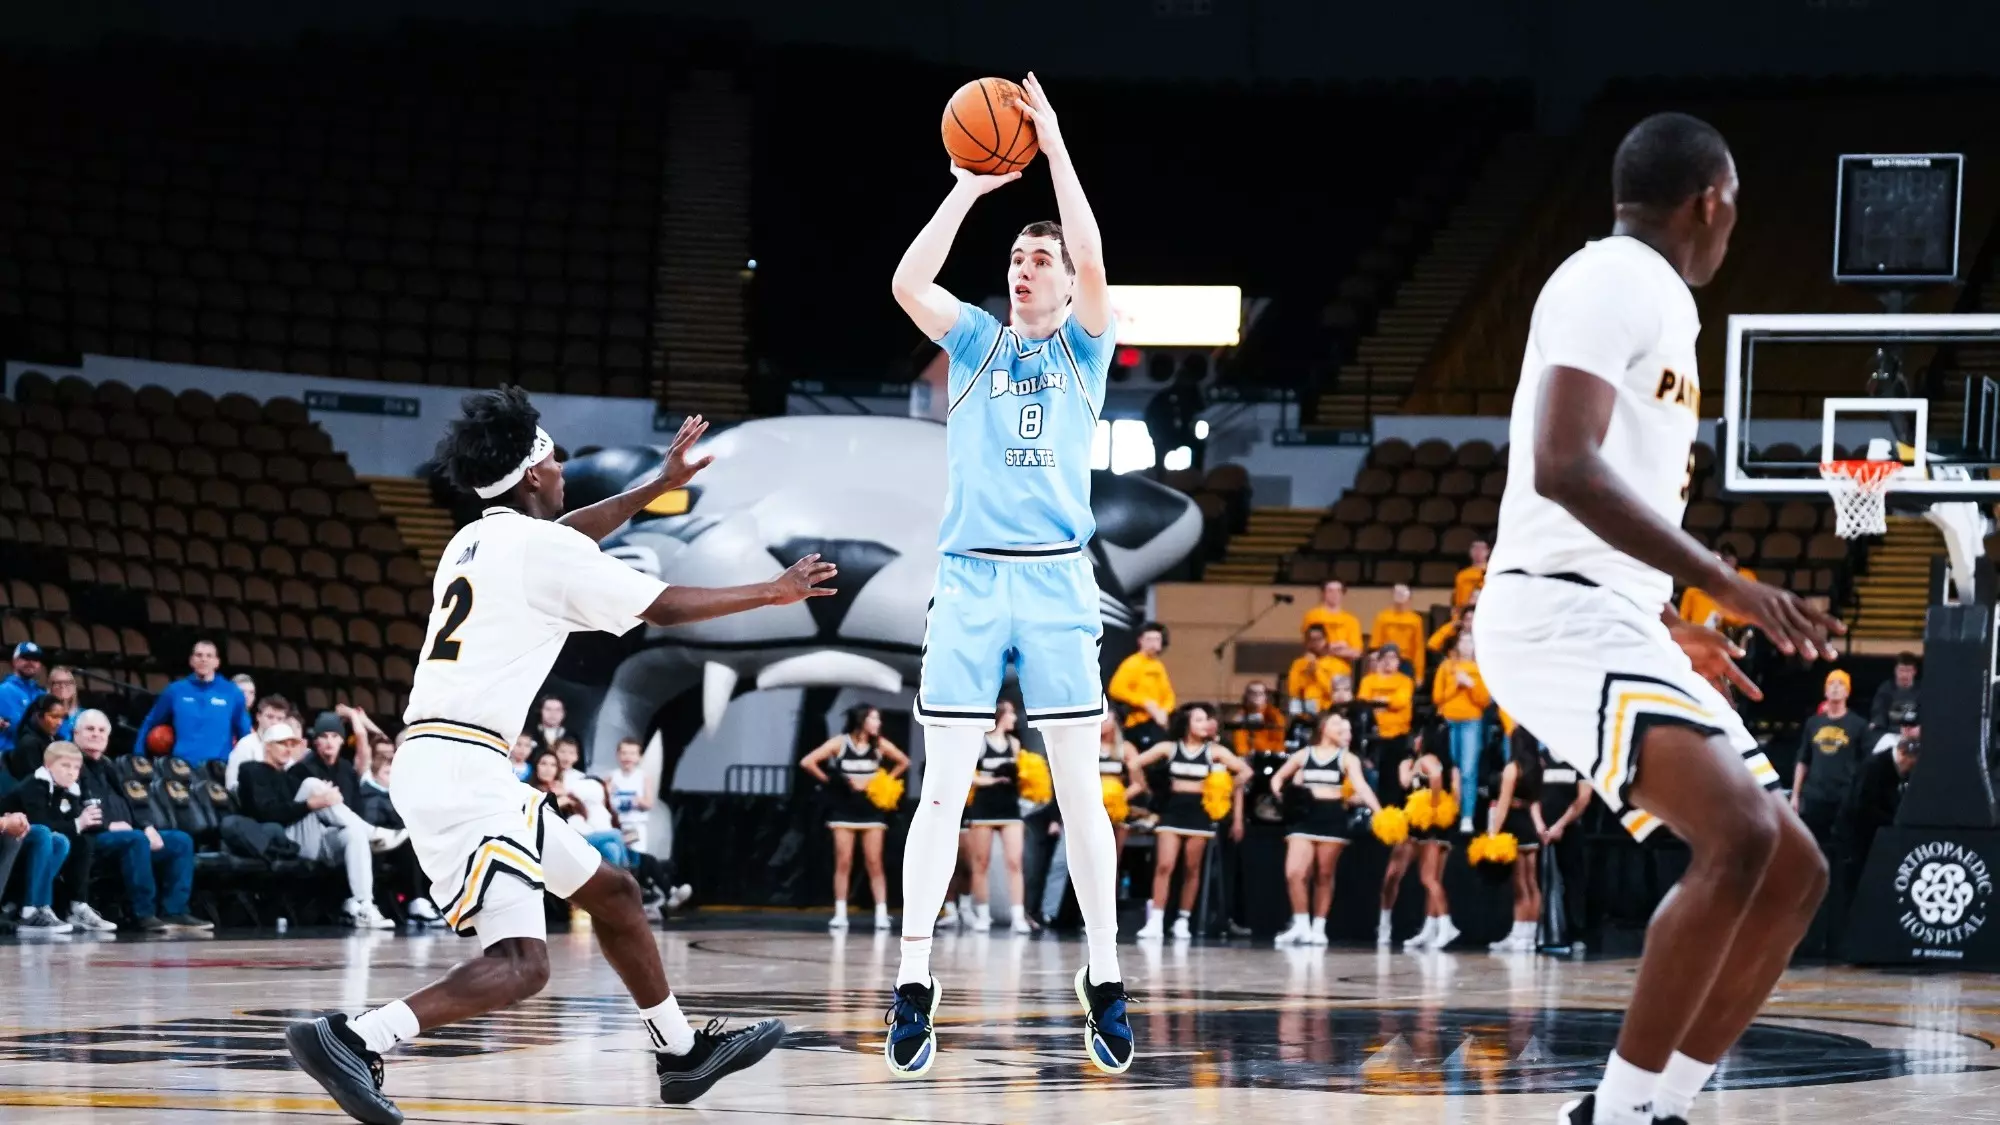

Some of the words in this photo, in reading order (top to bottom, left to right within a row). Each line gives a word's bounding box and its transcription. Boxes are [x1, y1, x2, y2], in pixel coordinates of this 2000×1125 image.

[1019, 402, 1044, 440] 8
[1005, 447, 1056, 468] STATE
[426, 575, 474, 662] 2
[1894, 840, 1993, 896] ORTHOPAEDIC
[1899, 910, 1986, 945] HOSPITAL
